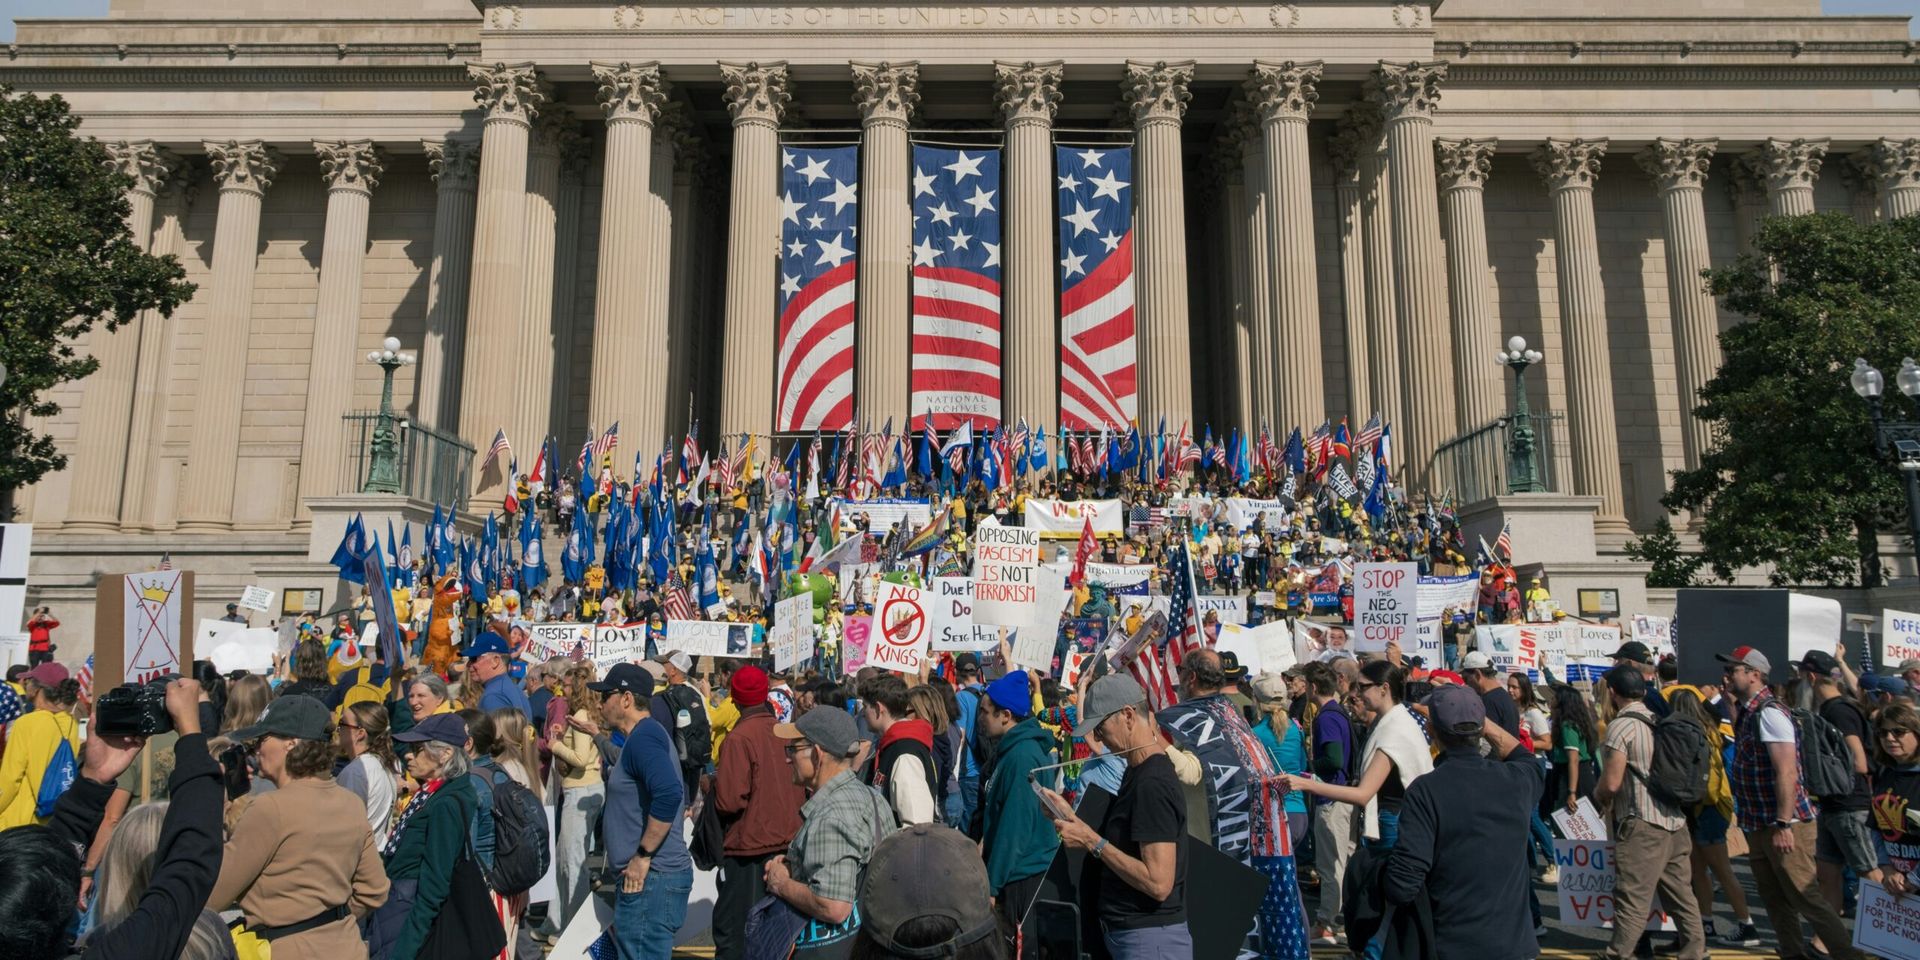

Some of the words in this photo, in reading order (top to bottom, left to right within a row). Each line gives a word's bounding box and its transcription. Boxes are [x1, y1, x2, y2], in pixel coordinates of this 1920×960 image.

[671, 7, 794, 25] ARCHIVES
[803, 7, 833, 25] OF
[844, 7, 887, 25] THE
[897, 7, 988, 25] UNITED
[998, 7, 1081, 25] STATES
[1089, 7, 1118, 25] OF
[1127, 7, 1246, 25] AMERICA
[926, 395, 987, 404] NATIONAL
[934, 404, 988, 413] RCHIVES
[1331, 467, 1357, 495] LIVES
[1247, 500, 1283, 510] Virginia
[979, 527, 1038, 546] OPPOSING
[979, 546, 1033, 563] FASCISM
[982, 565, 999, 581] IS
[1001, 566, 1034, 584] NOT
[1123, 566, 1152, 577] Loves
[1362, 569, 1405, 589] STOP
[890, 585, 920, 602] NO
[975, 583, 1036, 603] TERRORISM
[1312, 595, 1325, 603] Are
[1368, 598, 1402, 611] NEO-
[1361, 613, 1409, 625] FASCIST
[1893, 619, 1920, 635] DEFE
[537, 627, 576, 640] RESIST
[690, 623, 727, 637] ONLY
[1363, 625, 1405, 641] COUP
[1580, 627, 1614, 641] Loves
[1905, 637, 1920, 646] OU
[873, 642, 918, 667] KINGS
[1491, 656, 1502, 664] NO
[1887, 645, 1920, 660] DEMO
[1168, 708, 1226, 747] IN
[1208, 761, 1251, 866] AME
[1875, 897, 1920, 919] STATEHOO
[1865, 905, 1883, 919] FOR
[1886, 911, 1902, 925] THE
[1904, 917, 1920, 931] PEO
[1872, 918, 1886, 929] OF
[1886, 925, 1900, 936] DC
